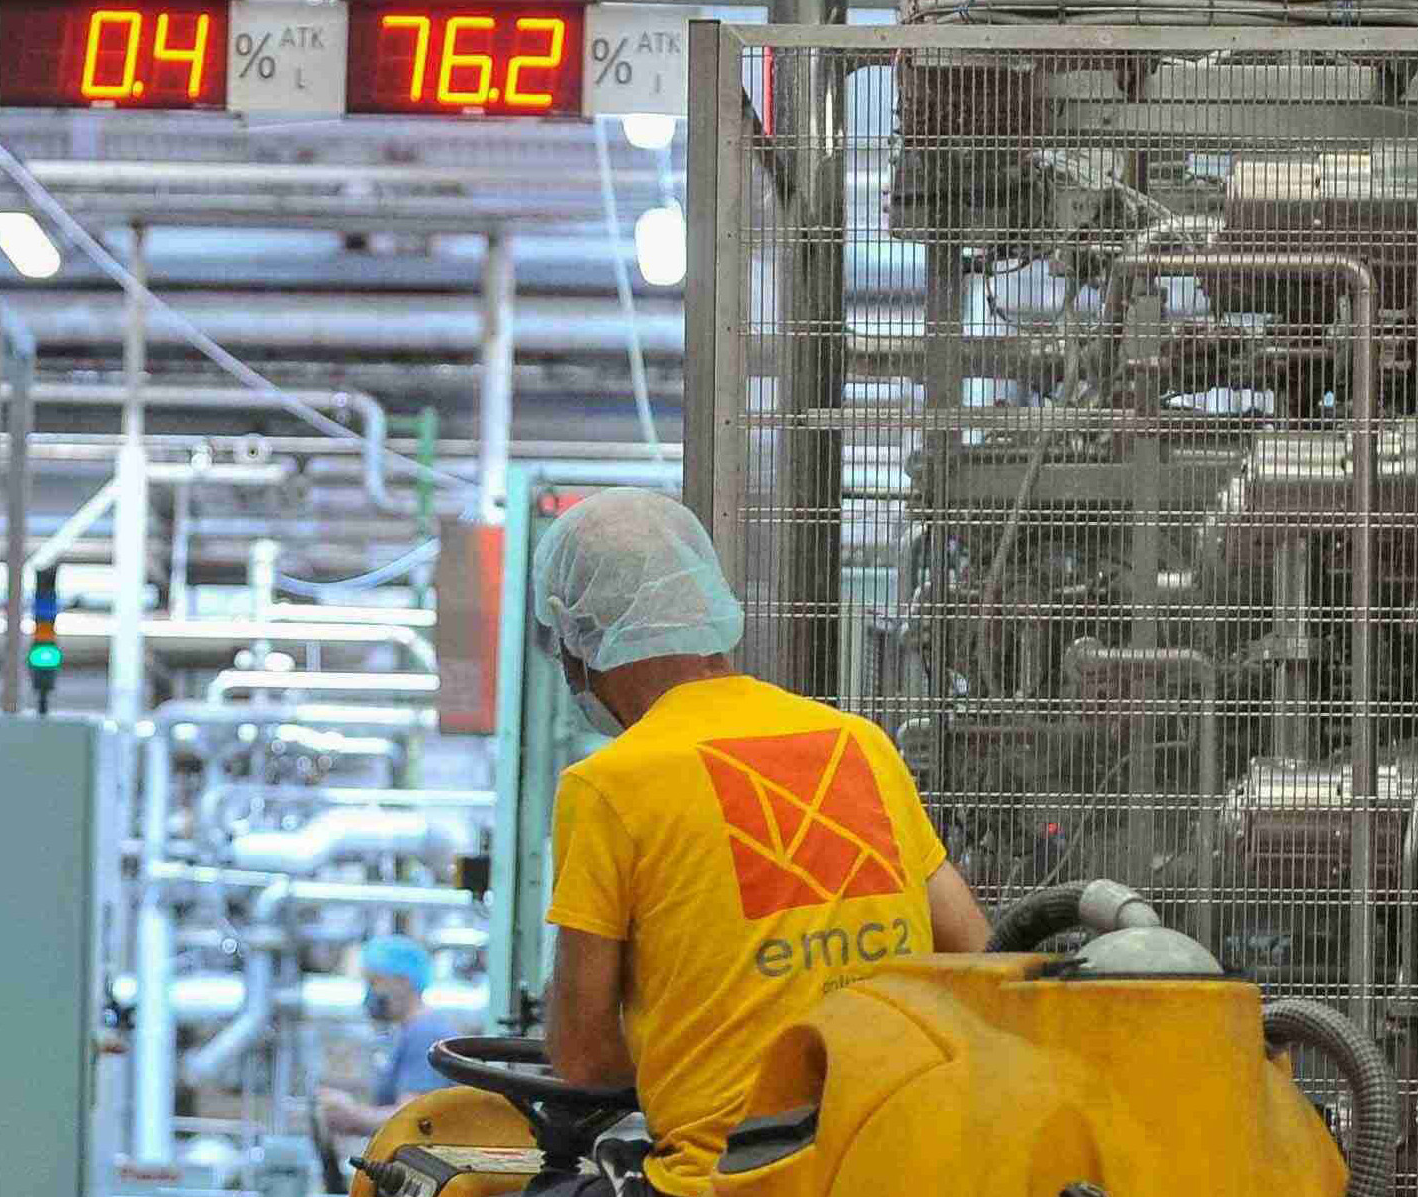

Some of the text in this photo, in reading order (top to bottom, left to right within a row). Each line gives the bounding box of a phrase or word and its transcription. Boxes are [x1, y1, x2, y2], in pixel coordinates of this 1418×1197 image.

[81, 10, 210, 98] 0.4
[235, 26, 324, 79] % ATK
[382, 14, 566, 107] 76.2
[592, 30, 682, 85] % ATK
[755, 917, 913, 978] emc2
